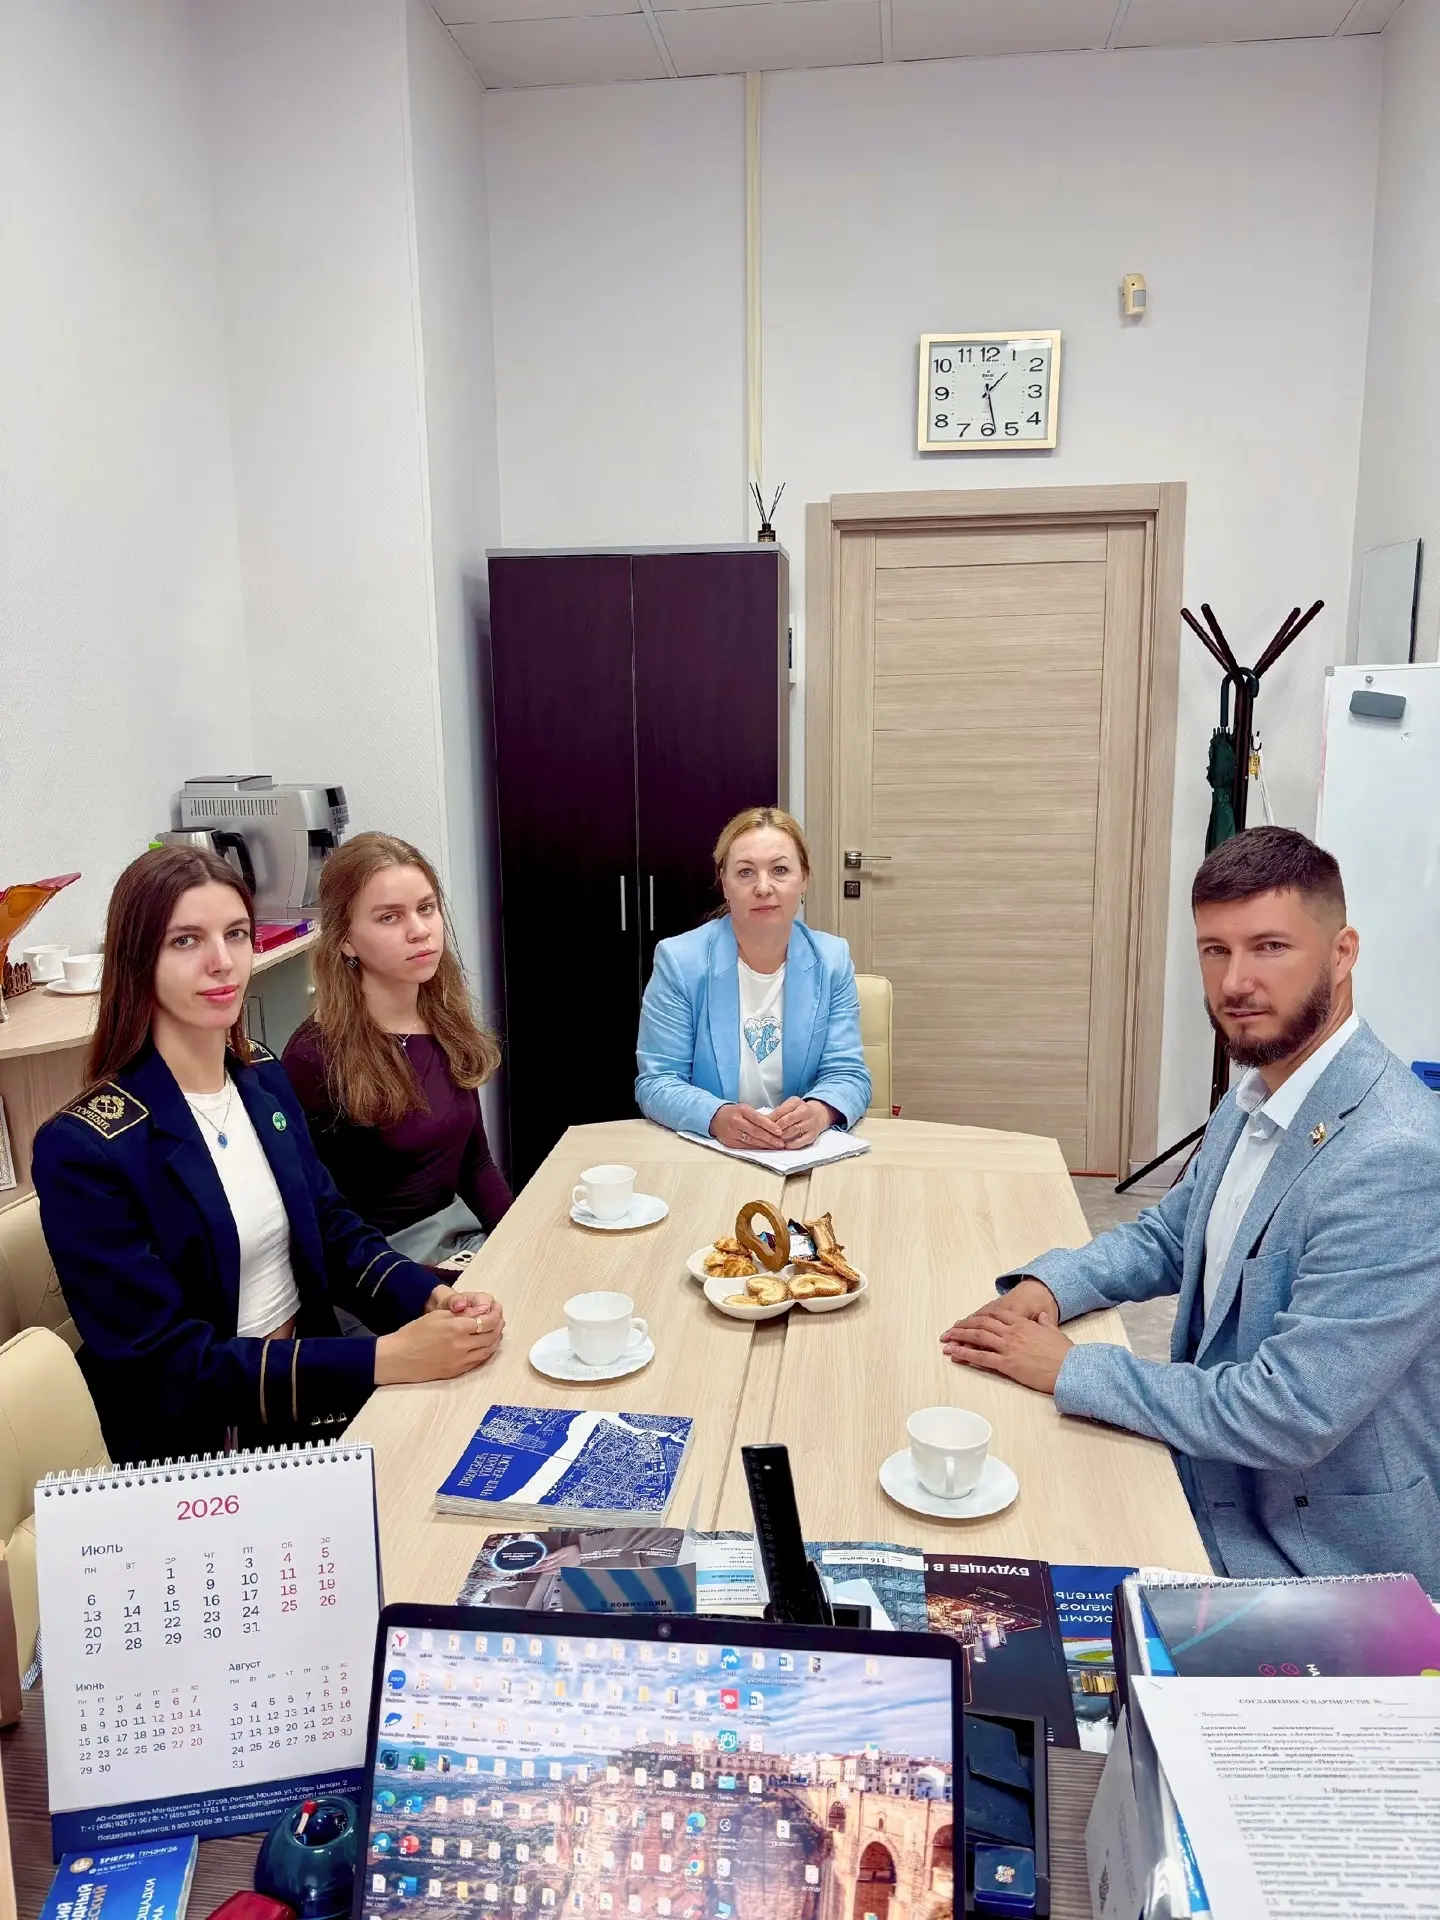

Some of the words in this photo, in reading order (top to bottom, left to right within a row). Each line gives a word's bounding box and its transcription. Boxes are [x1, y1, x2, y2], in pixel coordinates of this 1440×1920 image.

[958, 348, 972, 362] 11
[980, 347, 1000, 362] 12
[1011, 348, 1016, 361] 1
[933, 359, 952, 373] 10
[1029, 358, 1044, 372] 2
[935, 387, 949, 401] 9
[1028, 385, 1042, 398] 3
[935, 414, 948, 428] 8
[1027, 412, 1041, 425] 4
[957, 424, 971, 437] 7
[981, 423, 995, 436] 6
[1005, 422, 1019, 436] 5
[177, 1494, 240, 1521] 2026
[81, 1543, 123, 1556] Июль
[167, 1568, 175, 1579] 1
[206, 1563, 214, 1573] 2
[245, 1558, 253, 1568] 3
[284, 1553, 291, 1562] 4
[322, 1547, 329, 1558] 5
[932, 1565, 944, 1575] В
[949, 1562, 1029, 1577] БУДУЩЕЕ
[88, 1595, 95, 1605] 6
[128, 1590, 134, 1600] 7
[167, 1585, 175, 1595] 8
[206, 1579, 214, 1590] 9
[242, 1573, 258, 1585] 10
[280, 1568, 296, 1580] 11
[319, 1563, 334, 1574] 12
[84, 1611, 101, 1622] 13
[124, 1606, 140, 1617] 14
[164, 1600, 180, 1612] 15
[203, 1595, 220, 1606] 16
[242, 1589, 258, 1601] 17
[281, 1584, 297, 1596] 18
[319, 1579, 335, 1590] 19
[85, 1627, 101, 1638] 20
[125, 1622, 141, 1633] 21
[164, 1617, 180, 1628] 22
[204, 1612, 220, 1623] 23
[243, 1606, 259, 1617] 24
[282, 1600, 297, 1612] 25
[320, 1594, 336, 1606] 26
[86, 1643, 101, 1655] 27
[125, 1638, 142, 1650] 28
[165, 1633, 181, 1644] 29
[204, 1627, 221, 1639] 30
[243, 1622, 260, 1633] 31
[228, 1661, 261, 1672] Август
[341, 1672, 347, 1680] 2
[76, 1683, 105, 1692] Июнь
[118, 1705, 123, 1713] 3
[155, 1700, 160, 1708] 5
[193, 1695, 197, 1703] 7
[233, 1703, 238, 1711] 3
[288, 1695, 294, 1703] 6
[306, 1692, 311, 1700] 7
[341, 1686, 348, 1694] 9
[115, 1719, 127, 1728] 10
[134, 1717, 146, 1725] 11
[171, 1712, 182, 1720] 13
[190, 1709, 201, 1717] 14
[231, 1717, 243, 1726] 10
[250, 1715, 261, 1723] 11
[268, 1712, 278, 1720] 12
[286, 1709, 297, 1717] 13
[303, 1706, 315, 1715] 14
[321, 1703, 333, 1711] 15
[340, 1700, 351, 1708] 16
[231, 1732, 242, 1740] 17
[268, 1726, 279, 1734] 19
[286, 1723, 297, 1731] 20
[304, 1720, 315, 1729] 21
[322, 1717, 334, 1725] 22
[340, 1714, 352, 1722] 23
[79, 1738, 90, 1746] 15
[97, 1736, 109, 1744] 16
[118, 1734, 127, 1742] 17
[134, 1731, 146, 1740] 18
[153, 1728, 165, 1737] 19
[172, 1726, 183, 1735] 20
[190, 1724, 202, 1732] 21
[232, 1746, 243, 1754] 24
[250, 1743, 262, 1751] 25
[269, 1740, 280, 1748] 26
[287, 1737, 298, 1746] 27
[305, 1734, 316, 1742] 28
[323, 1731, 334, 1740] 29
[80, 1752, 91, 1760] 22
[98, 1750, 110, 1758] 23
[116, 1748, 128, 1756] 24
[135, 1745, 147, 1754] 25
[154, 1742, 166, 1751] 26
[172, 1740, 183, 1748] 27
[99, 1764, 110, 1772] 30
[233, 1760, 244, 1768] 31
